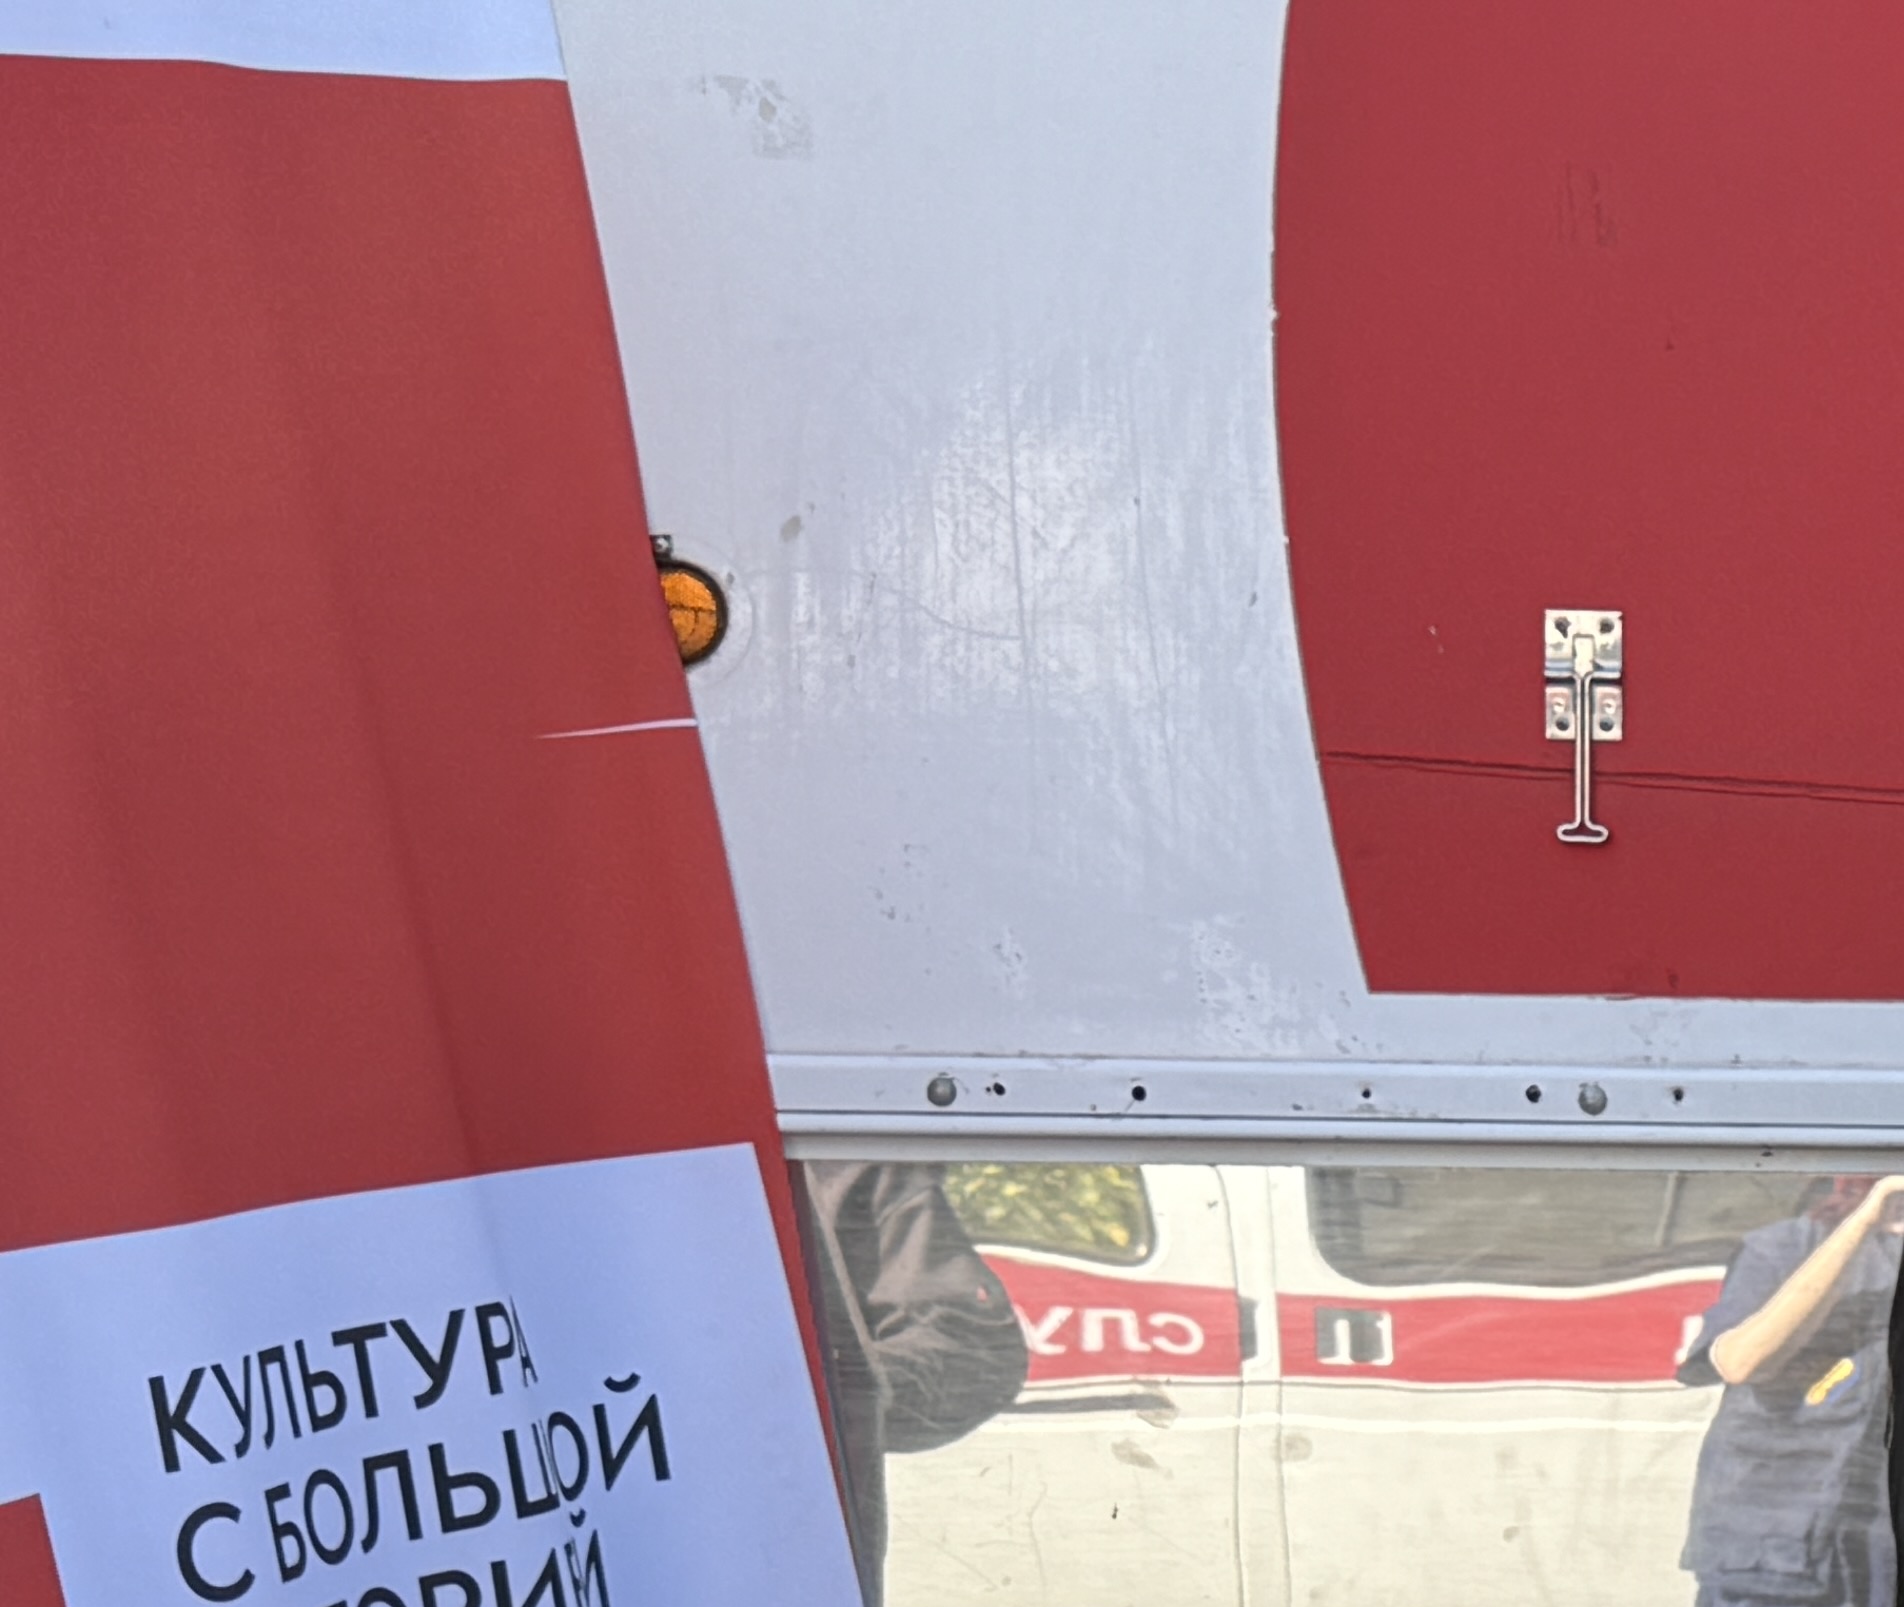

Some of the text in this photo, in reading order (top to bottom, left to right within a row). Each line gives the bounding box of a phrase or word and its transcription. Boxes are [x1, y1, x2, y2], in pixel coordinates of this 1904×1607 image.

[147, 1294, 539, 1474] КУЛЬТУРА
[176, 1370, 673, 1603] С БОЛЬШОЙ
